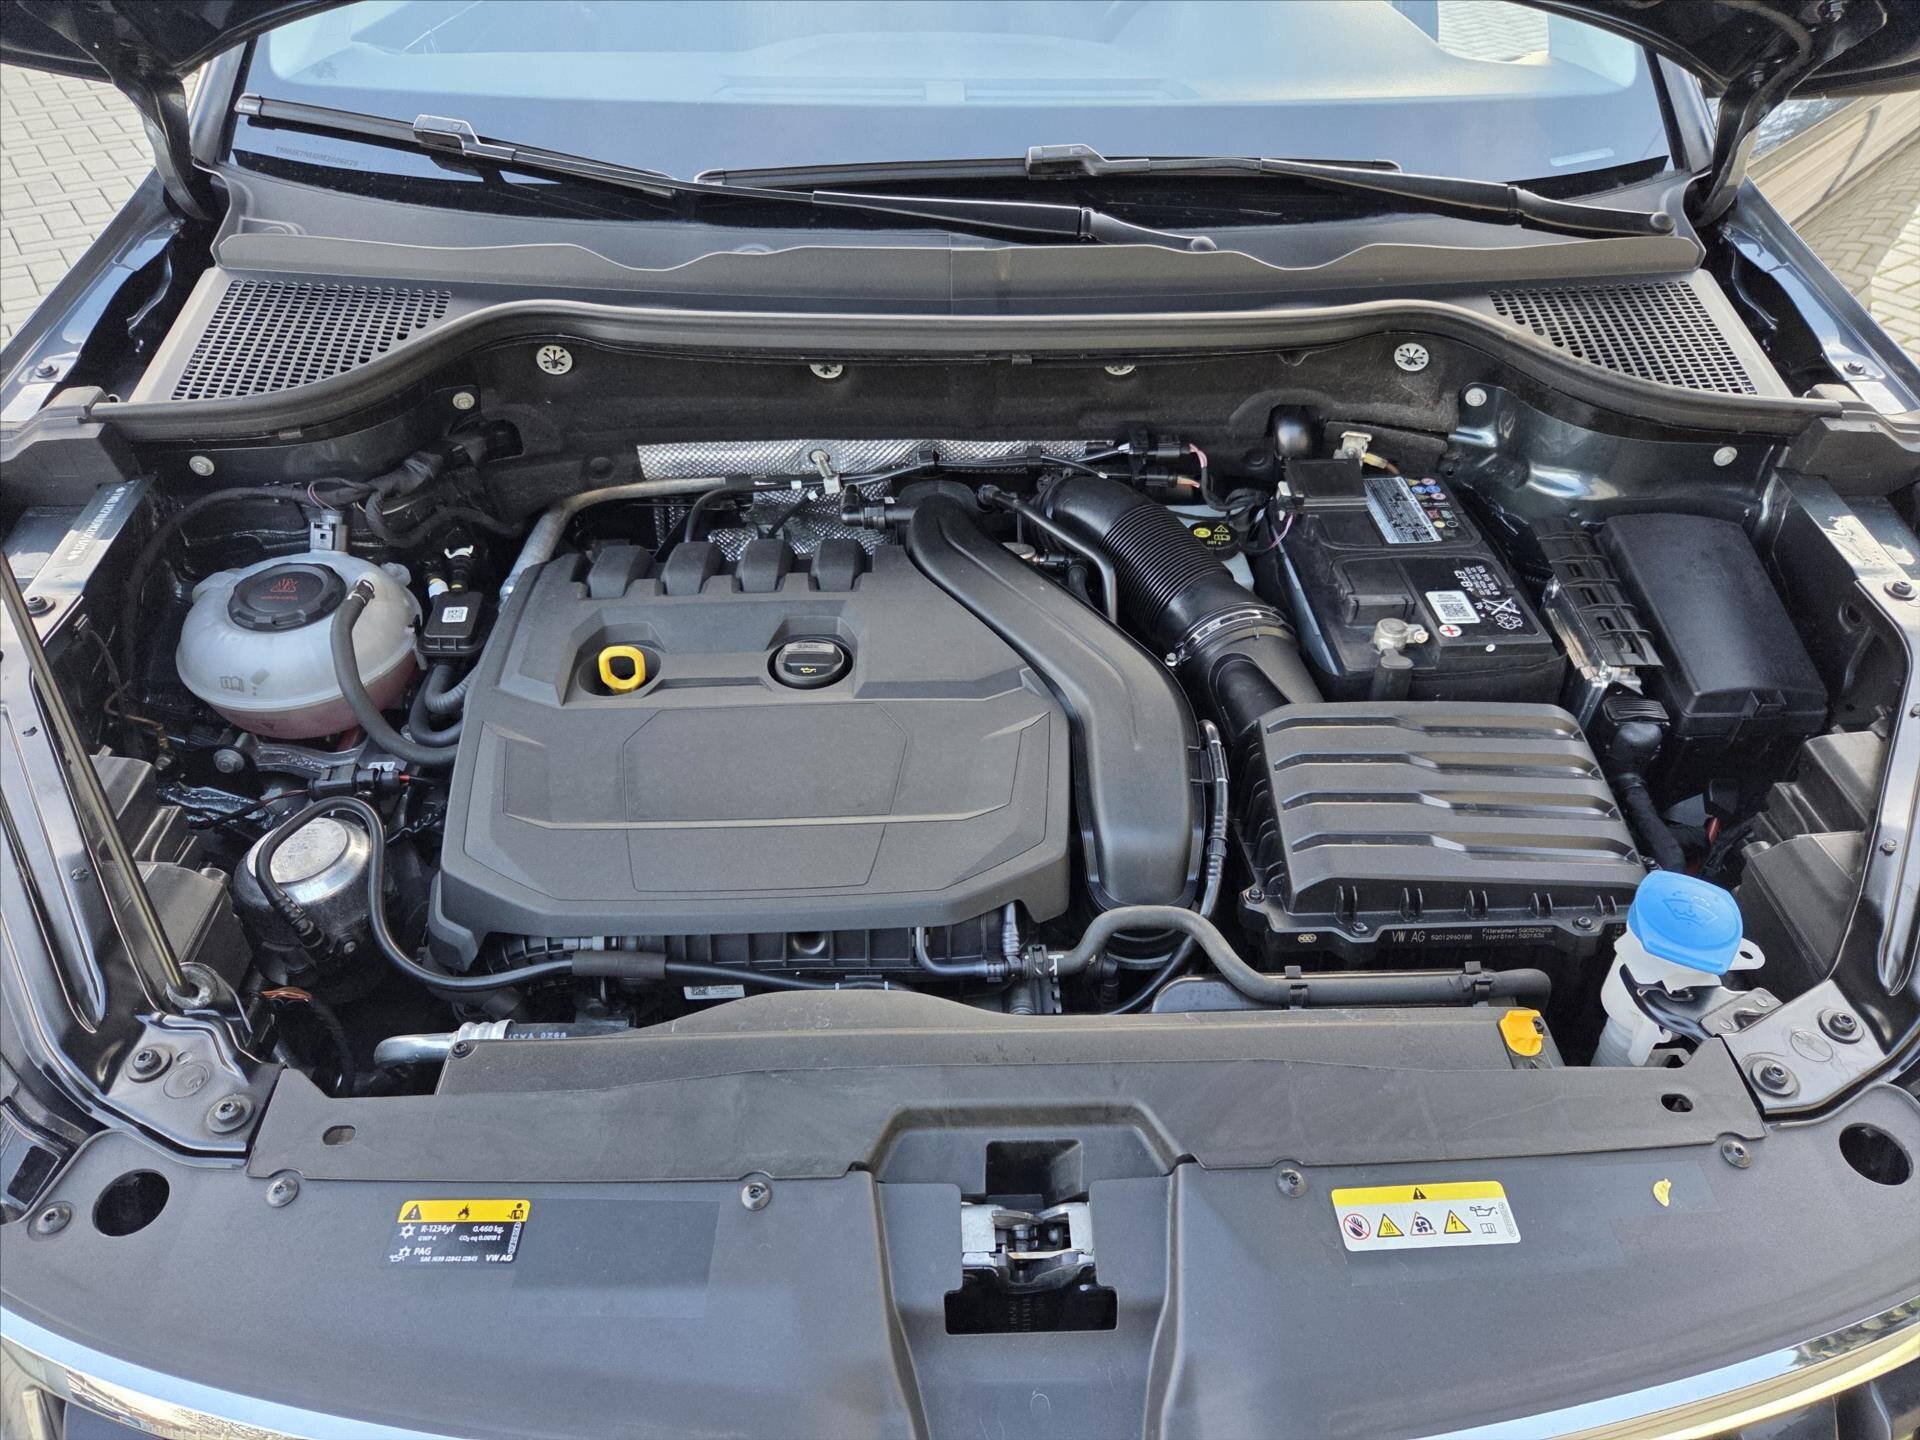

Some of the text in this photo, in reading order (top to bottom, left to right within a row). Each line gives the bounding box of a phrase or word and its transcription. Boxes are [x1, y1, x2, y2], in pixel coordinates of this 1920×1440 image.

[1391, 930, 1406, 943] VW
[1410, 930, 1426, 943] AG
[420, 1223, 457, 1235] R-1234yf
[472, 1225, 493, 1233] 0.460
[413, 1246, 433, 1256] PAG
[485, 1254, 500, 1262] VW
[500, 1254, 514, 1262] AG
